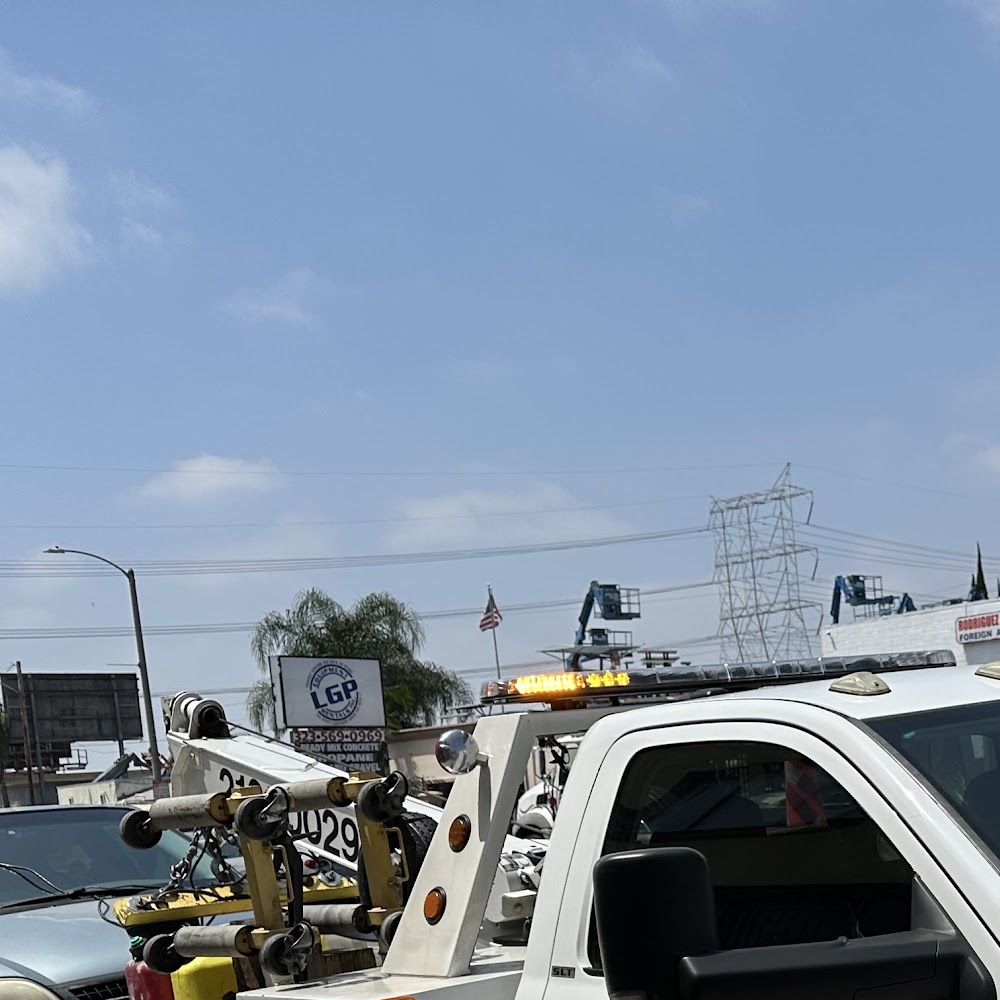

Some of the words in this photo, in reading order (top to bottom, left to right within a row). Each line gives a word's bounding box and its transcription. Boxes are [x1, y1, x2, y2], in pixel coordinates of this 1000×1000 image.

[958, 614, 999, 631] RODRIGUEZ
[959, 629, 992, 641] FOREIGN
[313, 666, 348, 688] EQUIPMENT
[310, 679, 358, 709] LGP
[320, 707, 351, 719] RENTALS
[327, 743, 342, 752] MIX
[343, 742, 380, 752] CONCRETE
[552, 967, 573, 977] SLT
